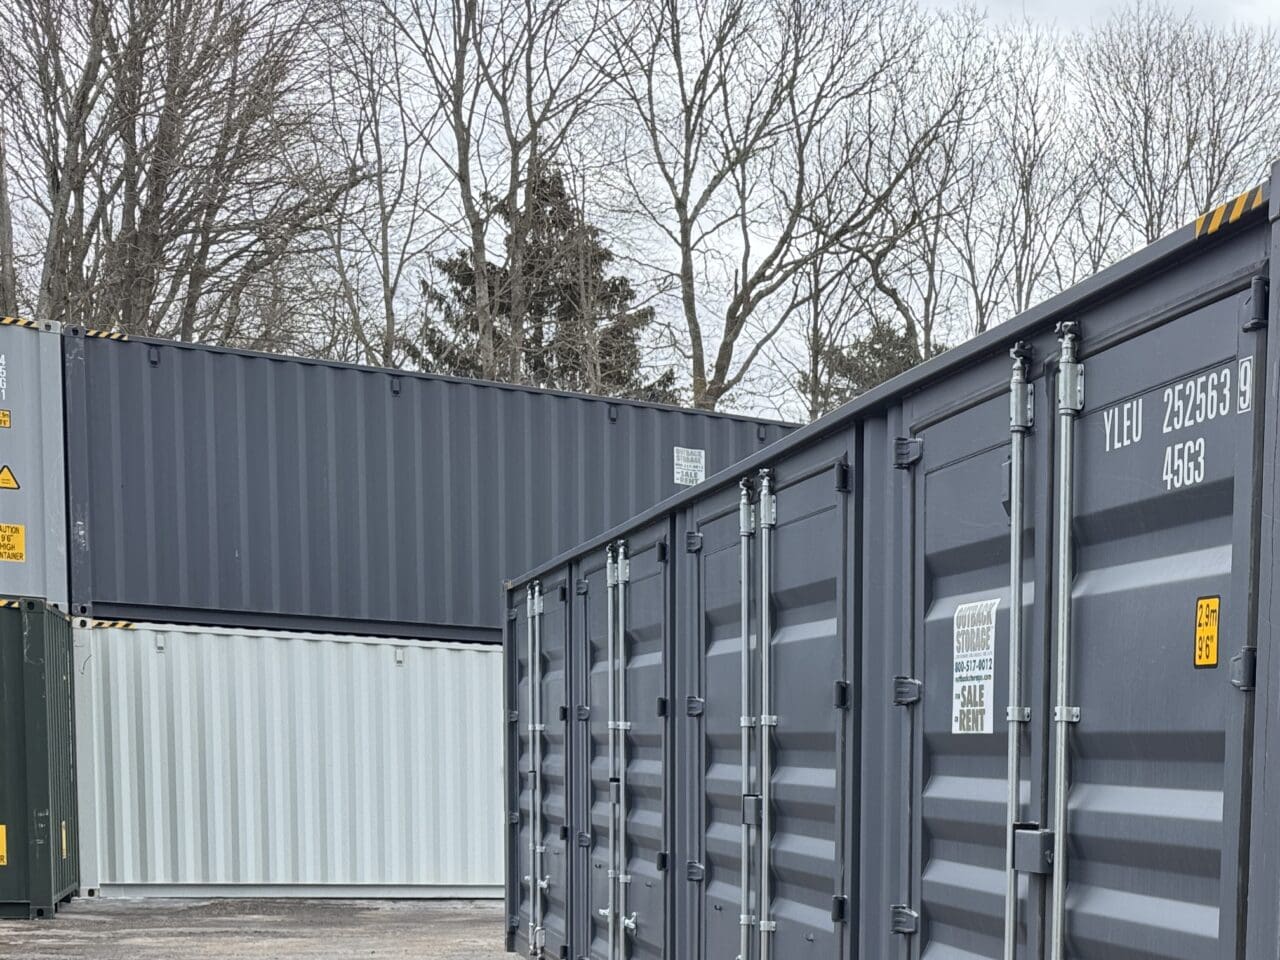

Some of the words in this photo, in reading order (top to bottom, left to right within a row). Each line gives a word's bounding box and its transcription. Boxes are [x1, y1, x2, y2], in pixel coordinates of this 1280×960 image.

[1103, 398, 1143, 452] YLEU
[1162, 368, 1231, 434] 252563
[1162, 437, 1205, 490] 45G3
[0, 524, 20, 534] AUTION
[0, 551, 24, 561] NTAINER
[956, 602, 996, 630] OUTBACK
[956, 627, 991, 653] STORAGE
[960, 684, 985, 708] SALE
[959, 708, 986, 731] RENT
